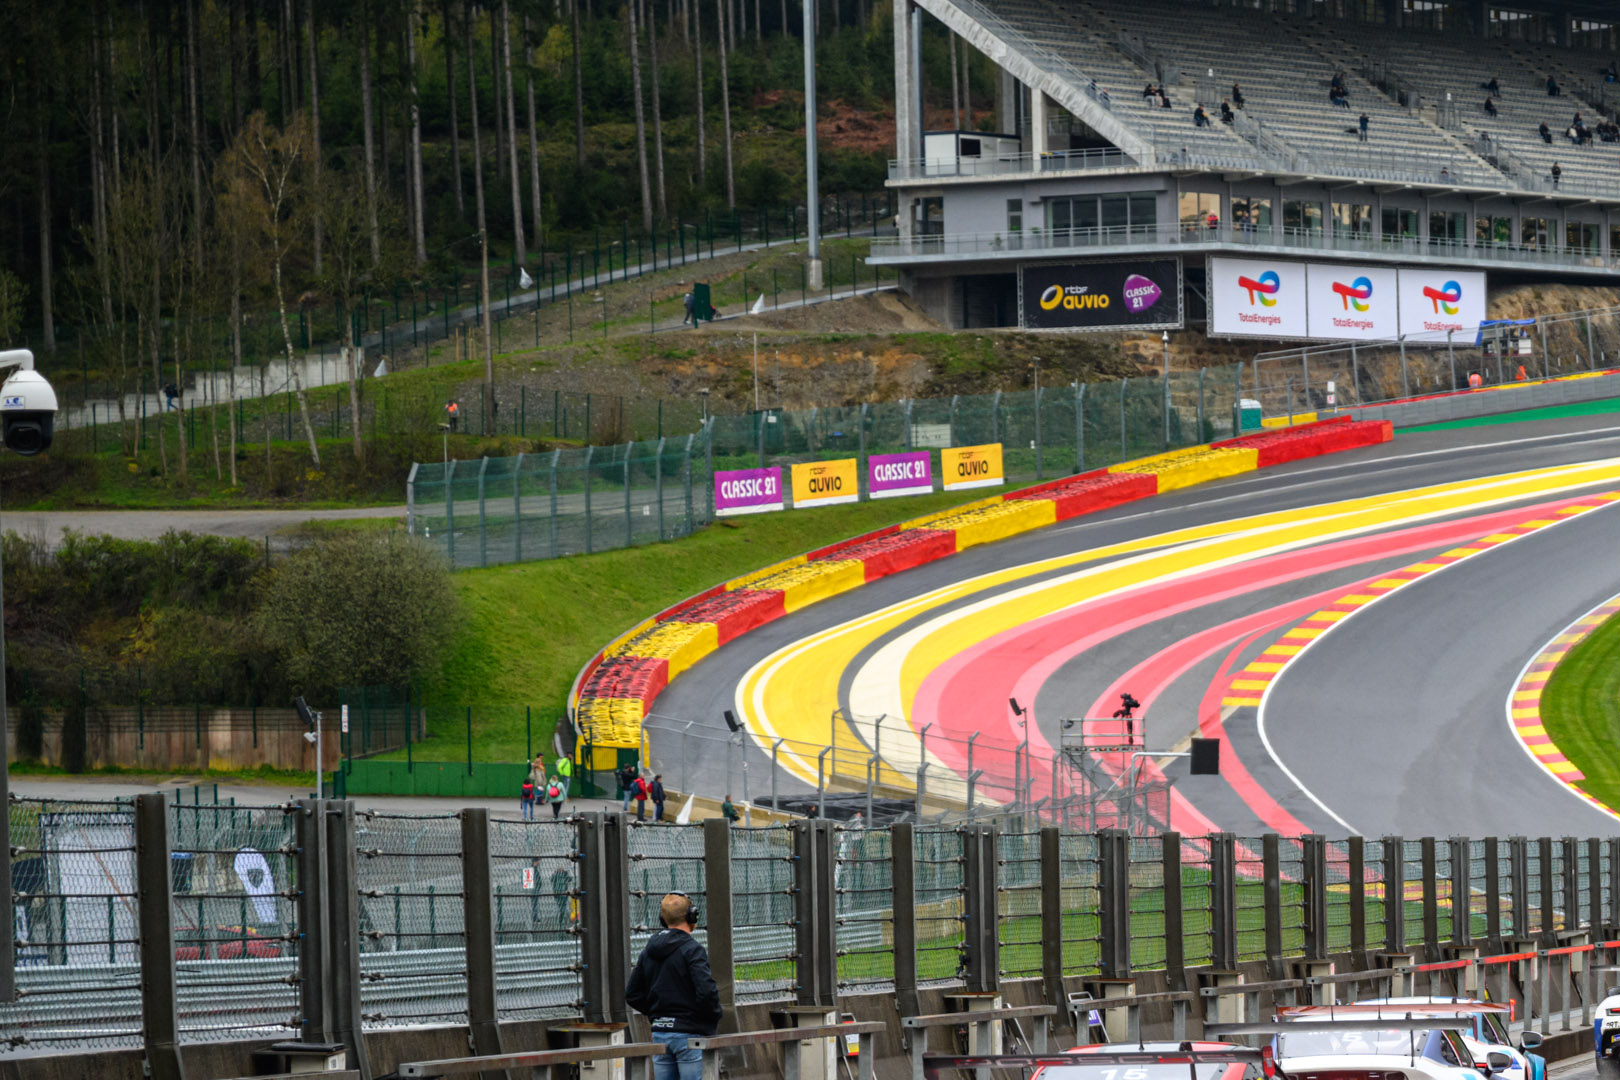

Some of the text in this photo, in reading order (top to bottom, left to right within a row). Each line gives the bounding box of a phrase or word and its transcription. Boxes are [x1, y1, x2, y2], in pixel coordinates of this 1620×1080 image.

[1125, 284, 1155, 299] CLASSIC
[1132, 297, 1143, 308] 21
[1238, 312, 1281, 325] TotalEnergies
[1332, 317, 1374, 330] TotalEnergies
[1423, 321, 1463, 332] TotalEnergies
[874, 460, 926, 482] CLASSIC 21
[721, 476, 776, 499] CLASSIC 21
[1100, 1068, 1149, 1080] 15
